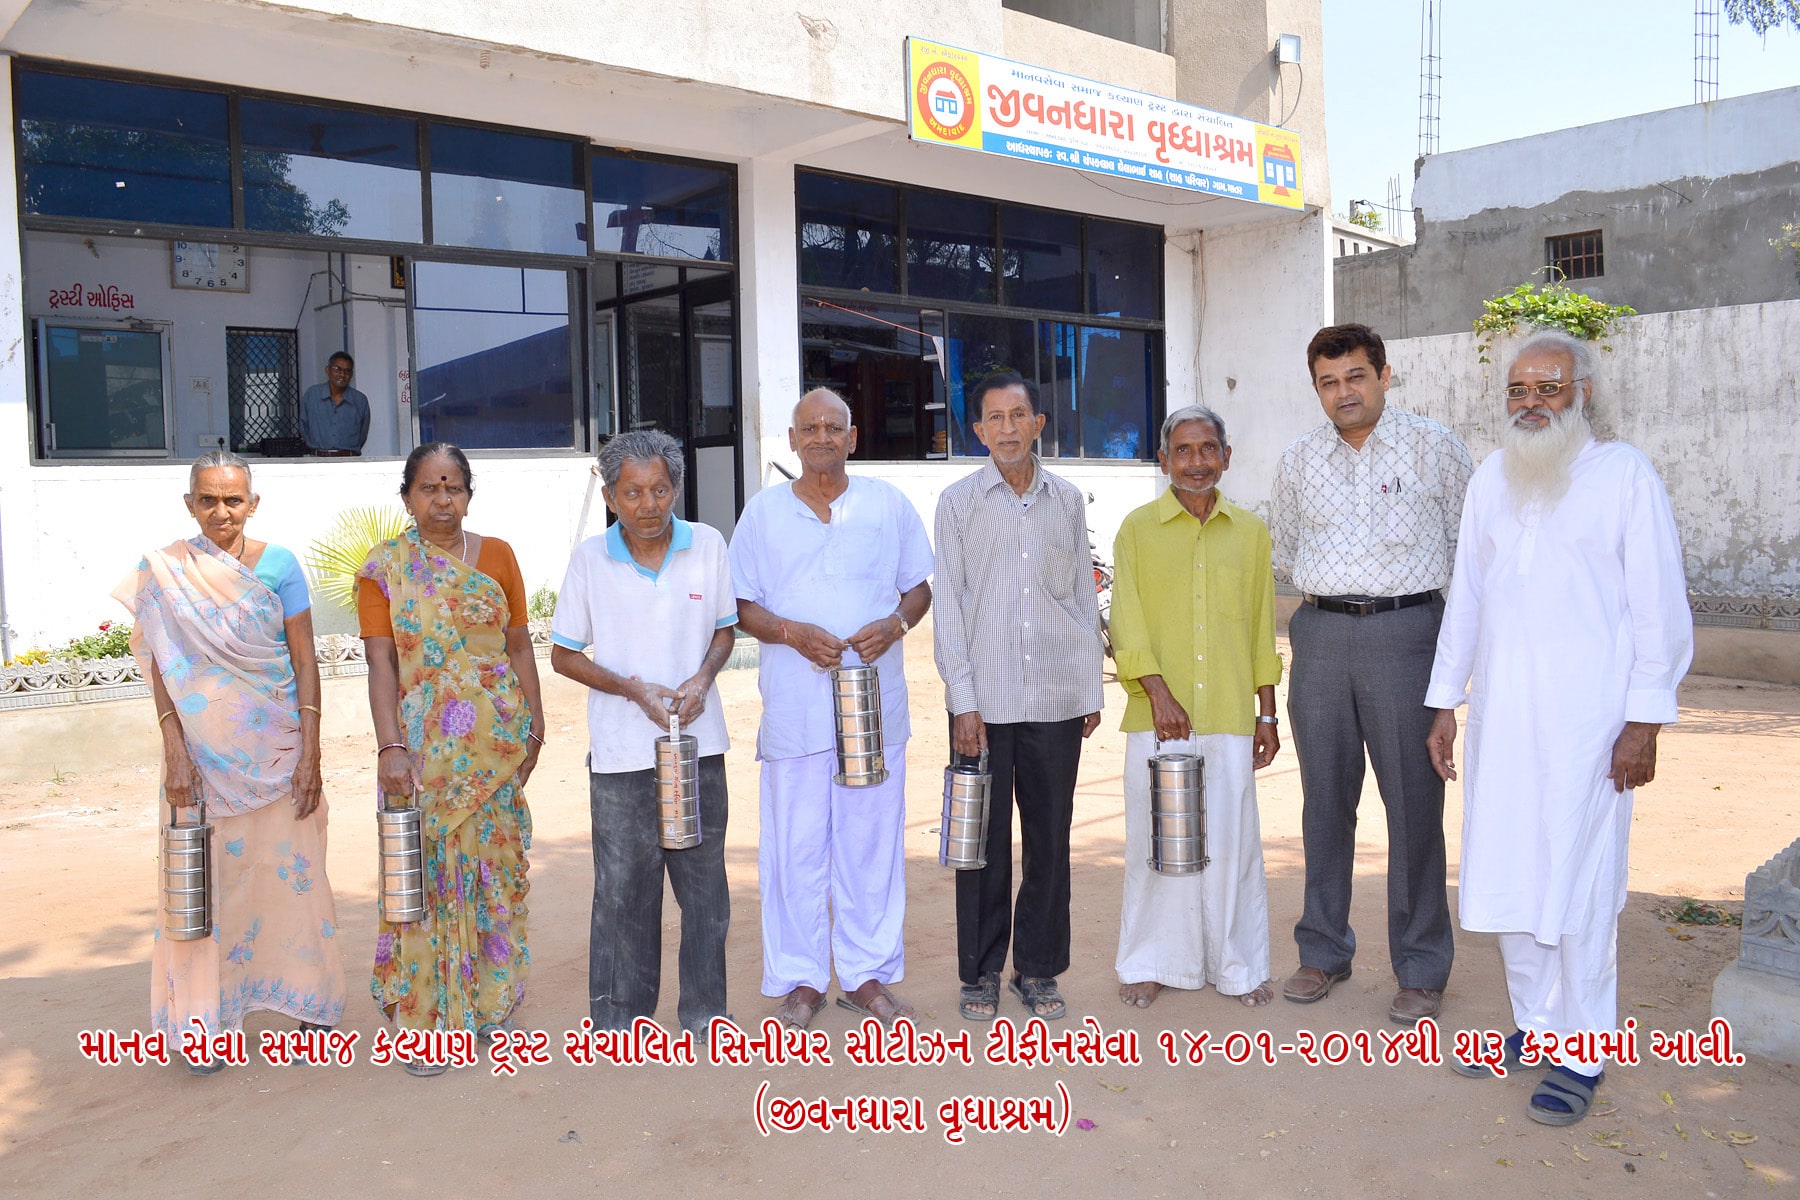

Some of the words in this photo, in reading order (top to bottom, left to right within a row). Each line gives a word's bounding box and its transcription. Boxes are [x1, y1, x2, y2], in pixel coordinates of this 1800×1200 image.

[1011, 69, 1065, 89] માનવસેવા
[1071, 83, 1102, 97] સમાજ
[1108, 92, 1143, 107] કલ્યાણ
[1148, 101, 1167, 112] ટ્રસ્ટ
[1197, 113, 1233, 129] સંચાલિત
[987, 84, 1134, 141] જીવનધારા
[1147, 120, 1254, 168] વૃધ્ધાશ્રમ
[177, 241, 188, 250] 10
[232, 245, 240, 253] 2
[175, 255, 183, 263] 9
[237, 259, 245, 267] 3
[182, 270, 189, 278] 8
[231, 272, 238, 280] 4
[207, 280, 215, 288] 6
[220, 279, 227, 287] 5
[49, 283, 83, 309] ટ્રસ્ટી
[86, 283, 135, 312] ઓફિસ
